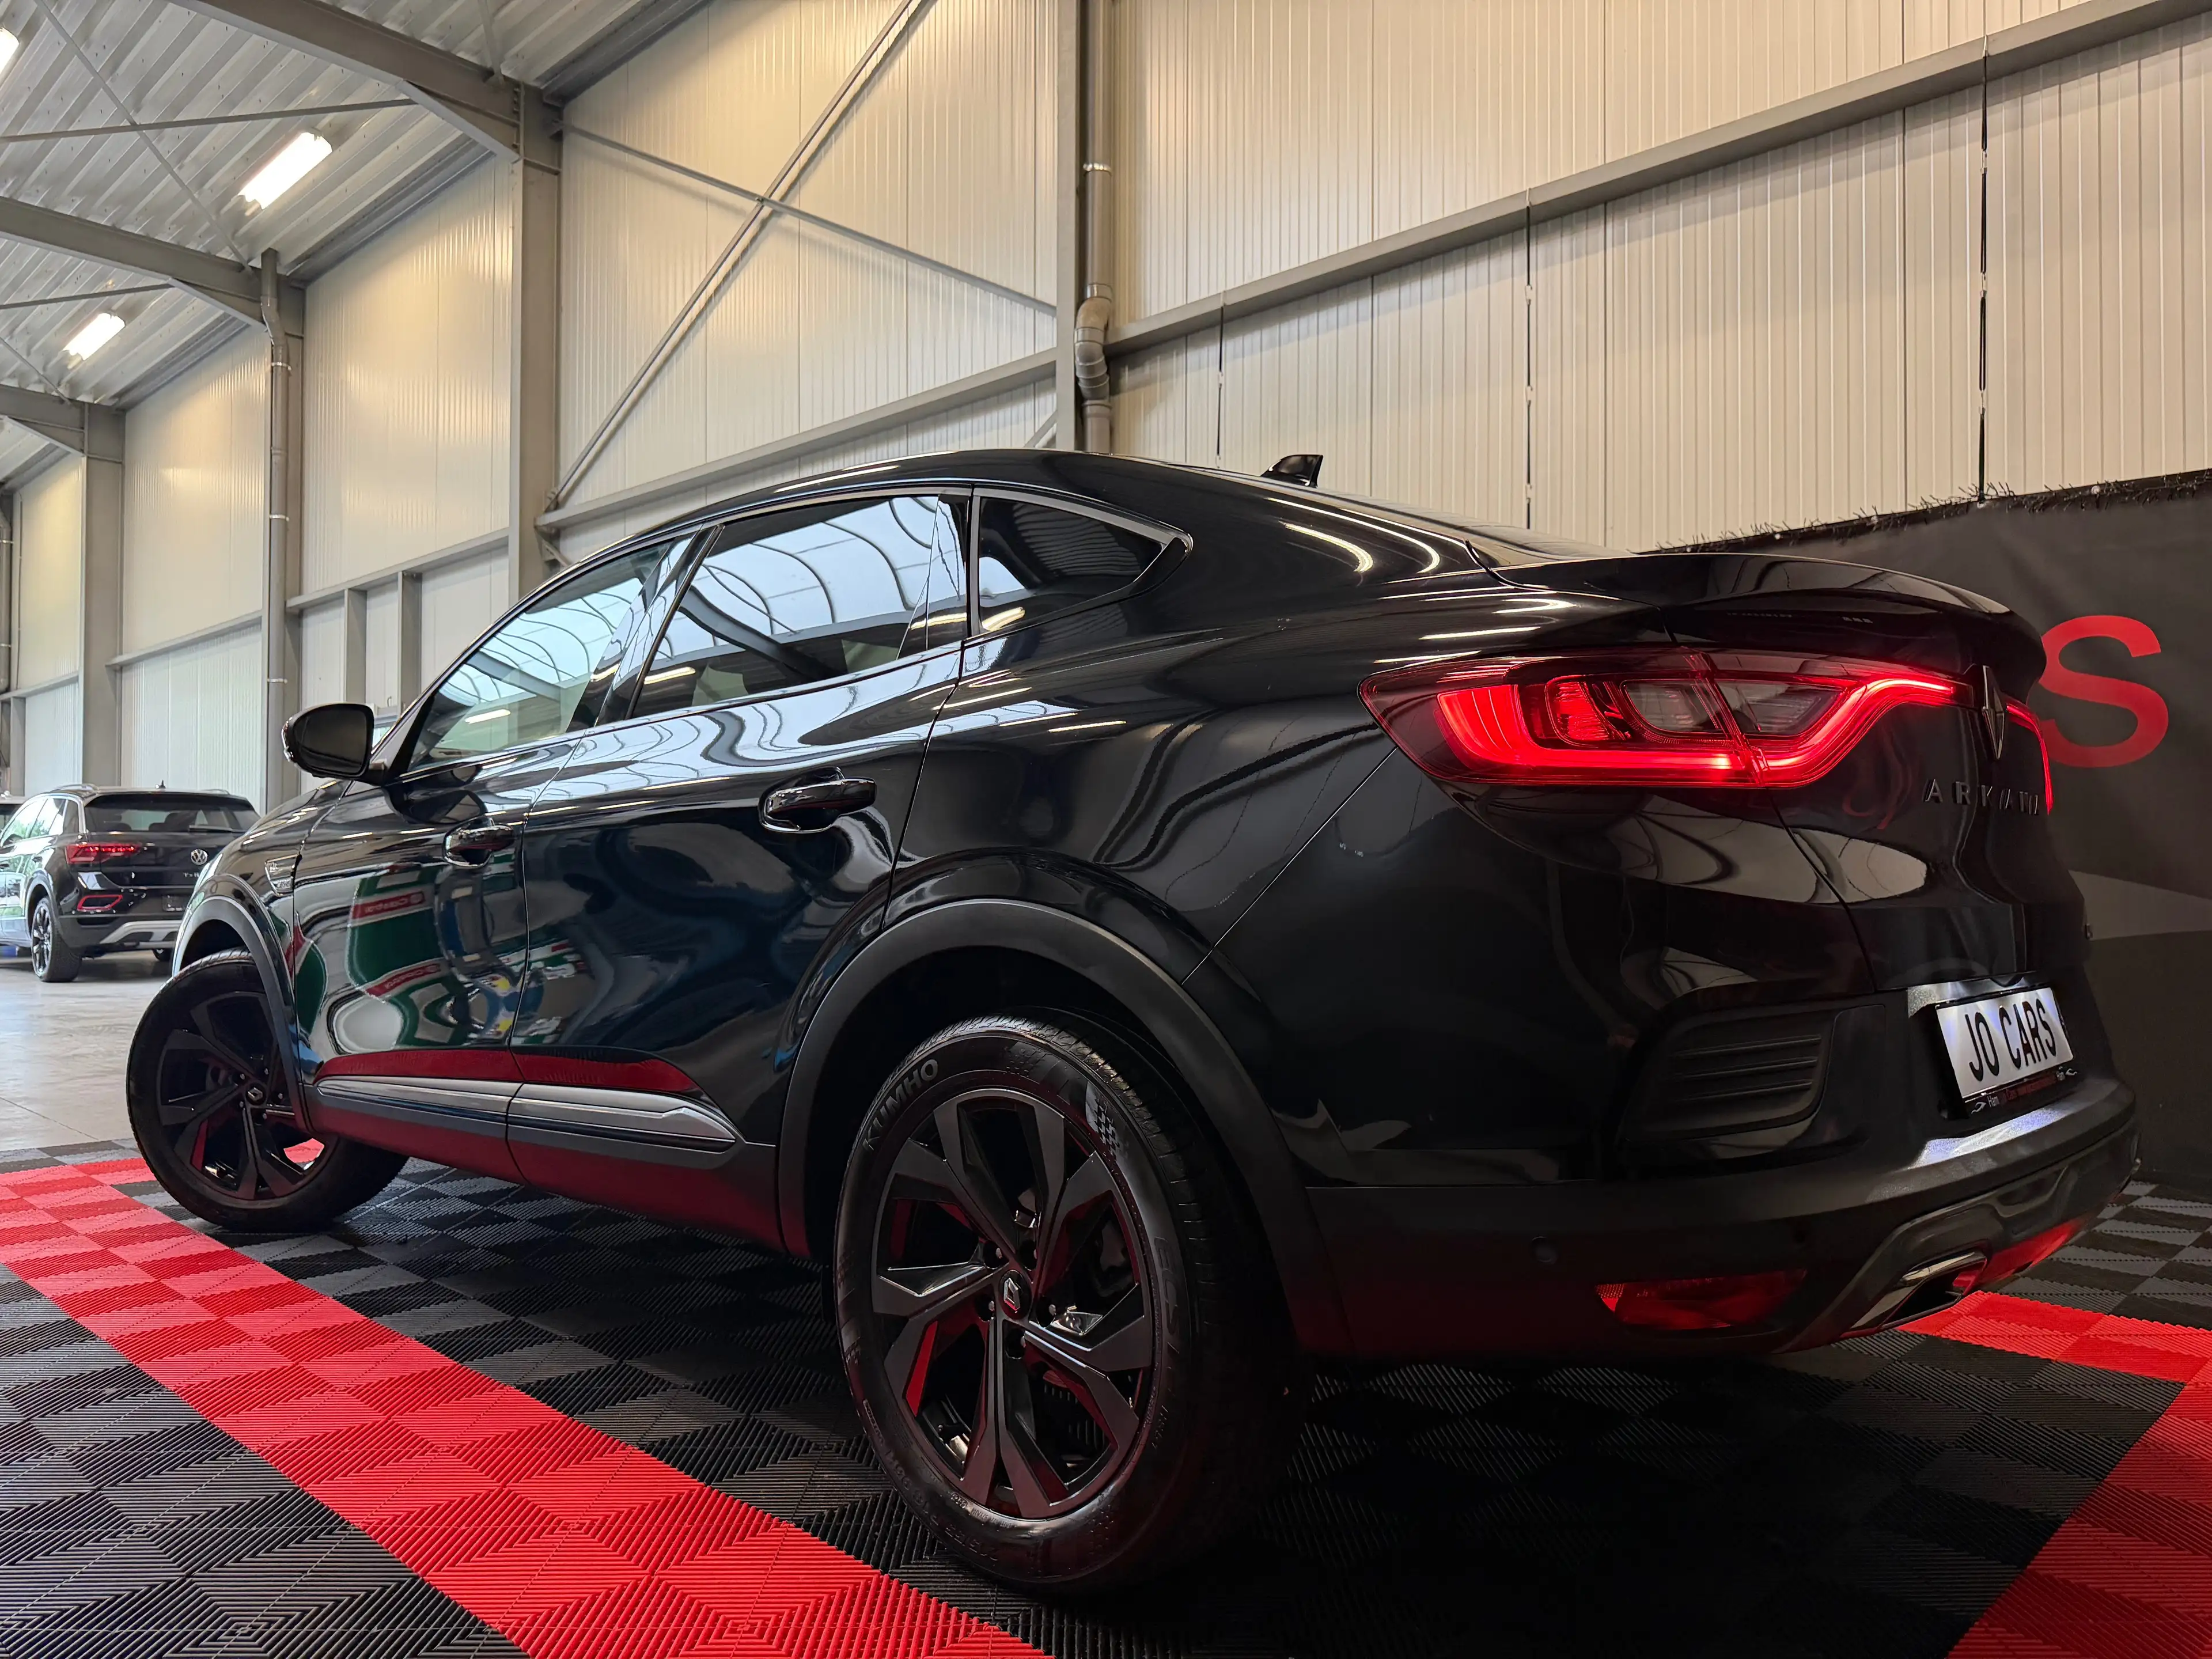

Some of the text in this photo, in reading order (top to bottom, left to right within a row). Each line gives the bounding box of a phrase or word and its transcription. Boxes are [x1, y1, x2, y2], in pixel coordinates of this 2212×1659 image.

[2038, 615, 2169, 767] S
[1965, 998, 2056, 1082] JO CARS
[862, 1058, 939, 1153] KUMHO
